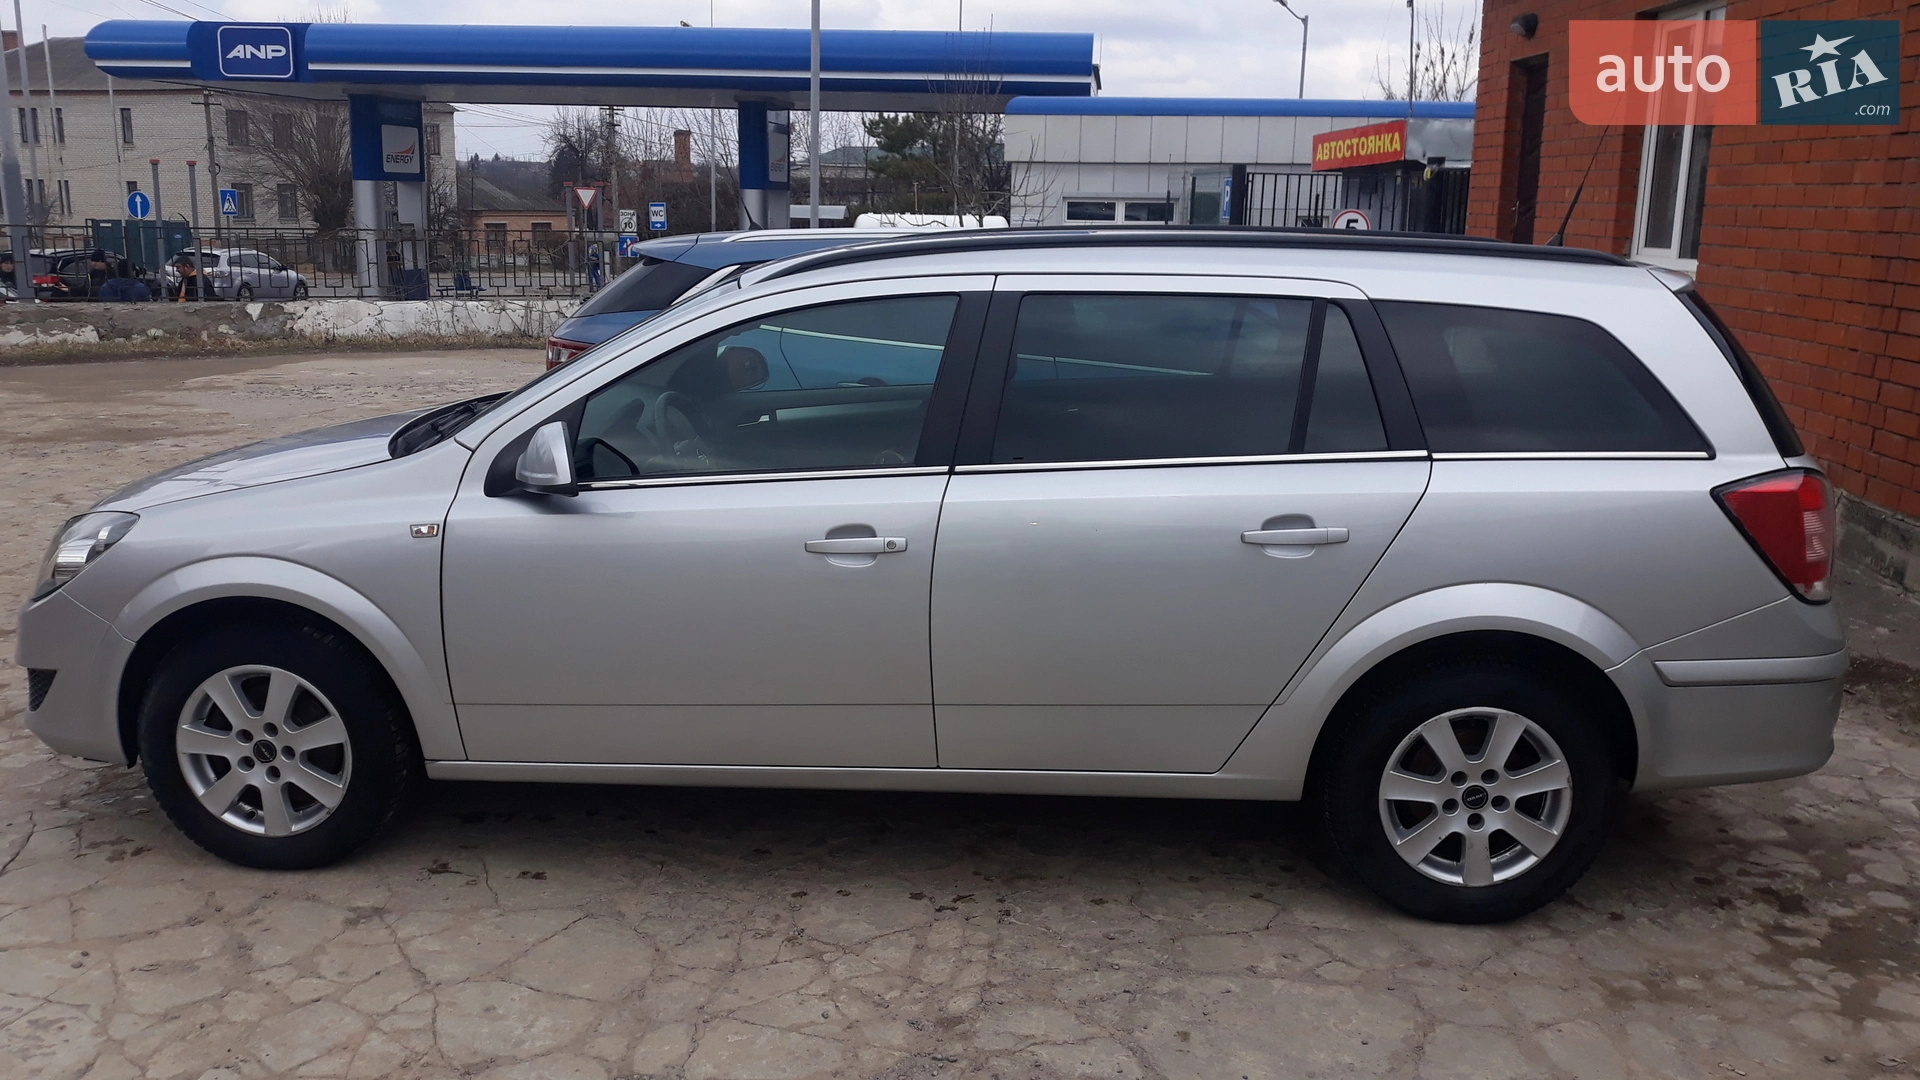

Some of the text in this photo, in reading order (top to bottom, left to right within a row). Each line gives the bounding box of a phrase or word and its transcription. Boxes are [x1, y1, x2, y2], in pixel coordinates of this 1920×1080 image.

[226, 44, 286, 59] ANP
[1316, 132, 1400, 161] АВТОСТОЯНКА
[386, 154, 414, 164] ENERGY
[651, 209, 664, 218] WC
[623, 221, 634, 229] 10
